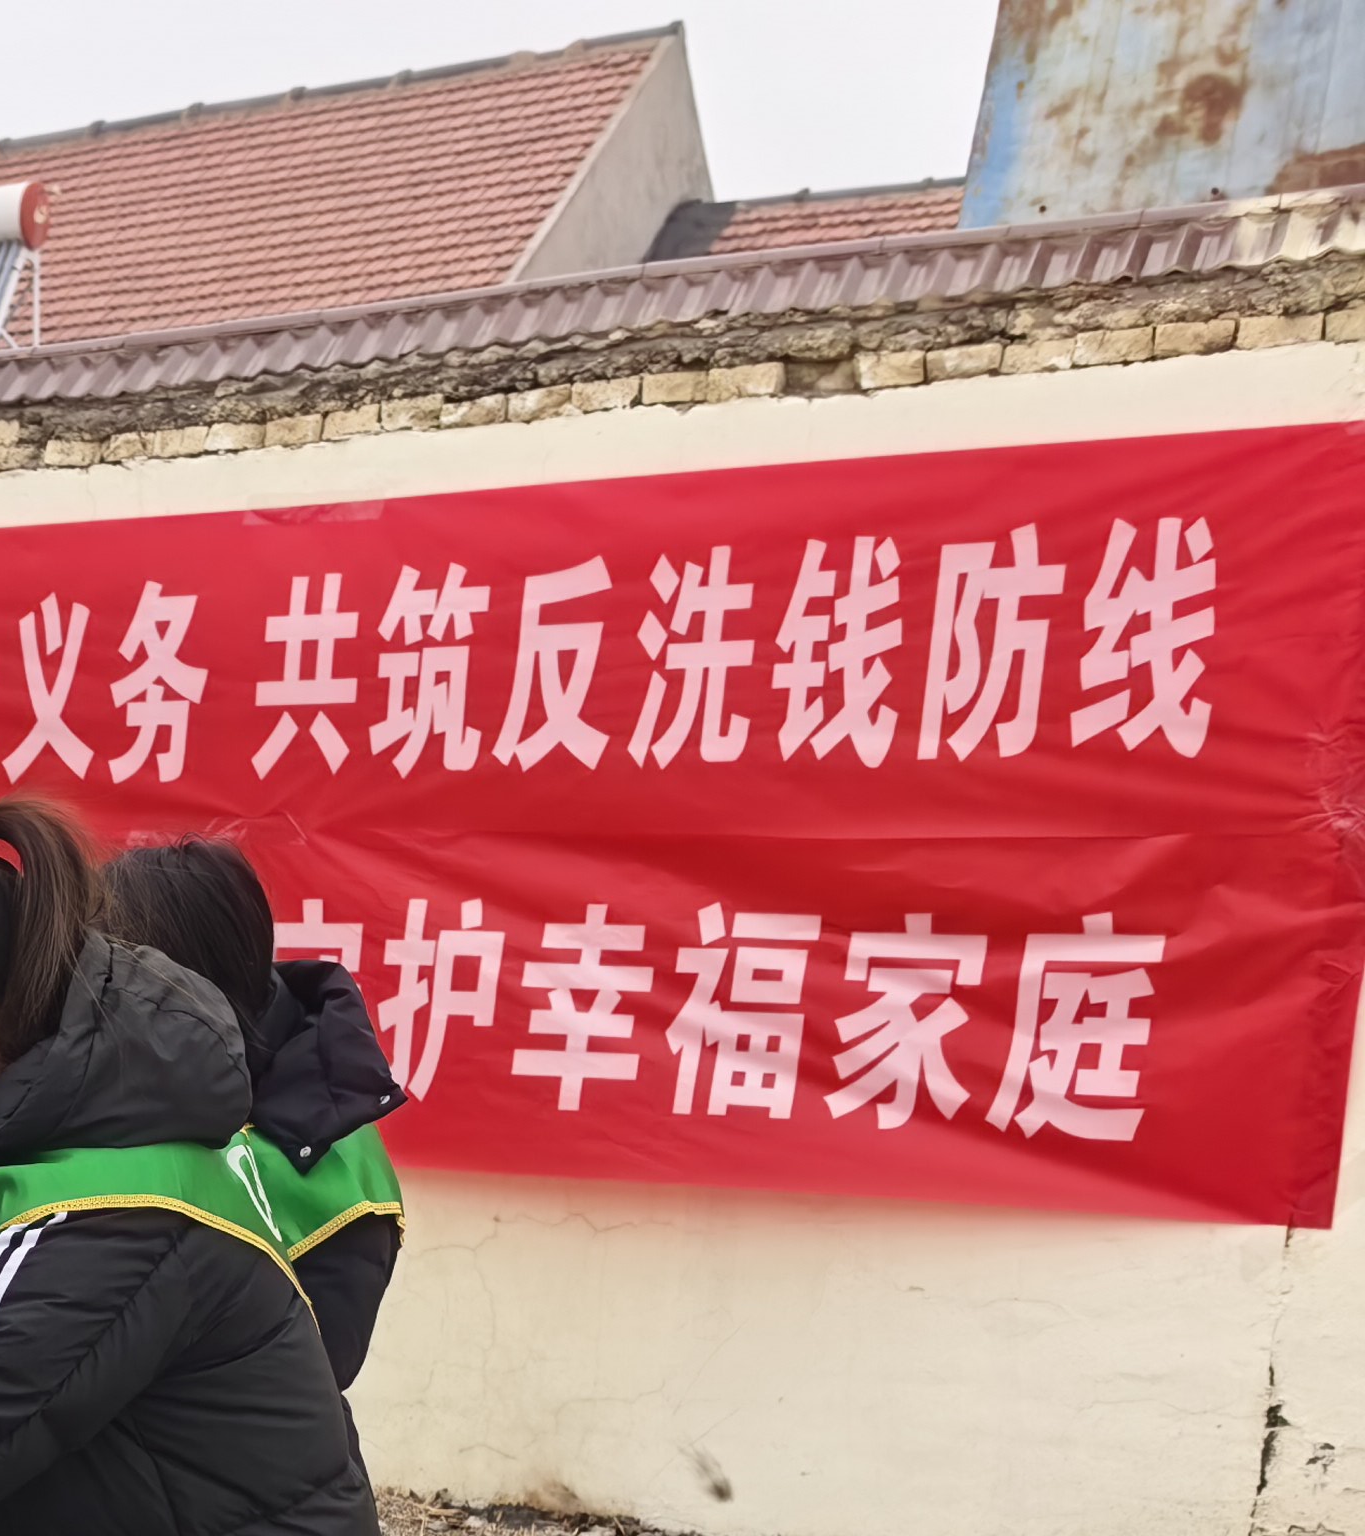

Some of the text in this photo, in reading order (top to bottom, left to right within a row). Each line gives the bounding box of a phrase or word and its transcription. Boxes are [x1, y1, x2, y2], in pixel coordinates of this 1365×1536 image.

[251, 517, 1216, 779] 共筑反洗钱防线
